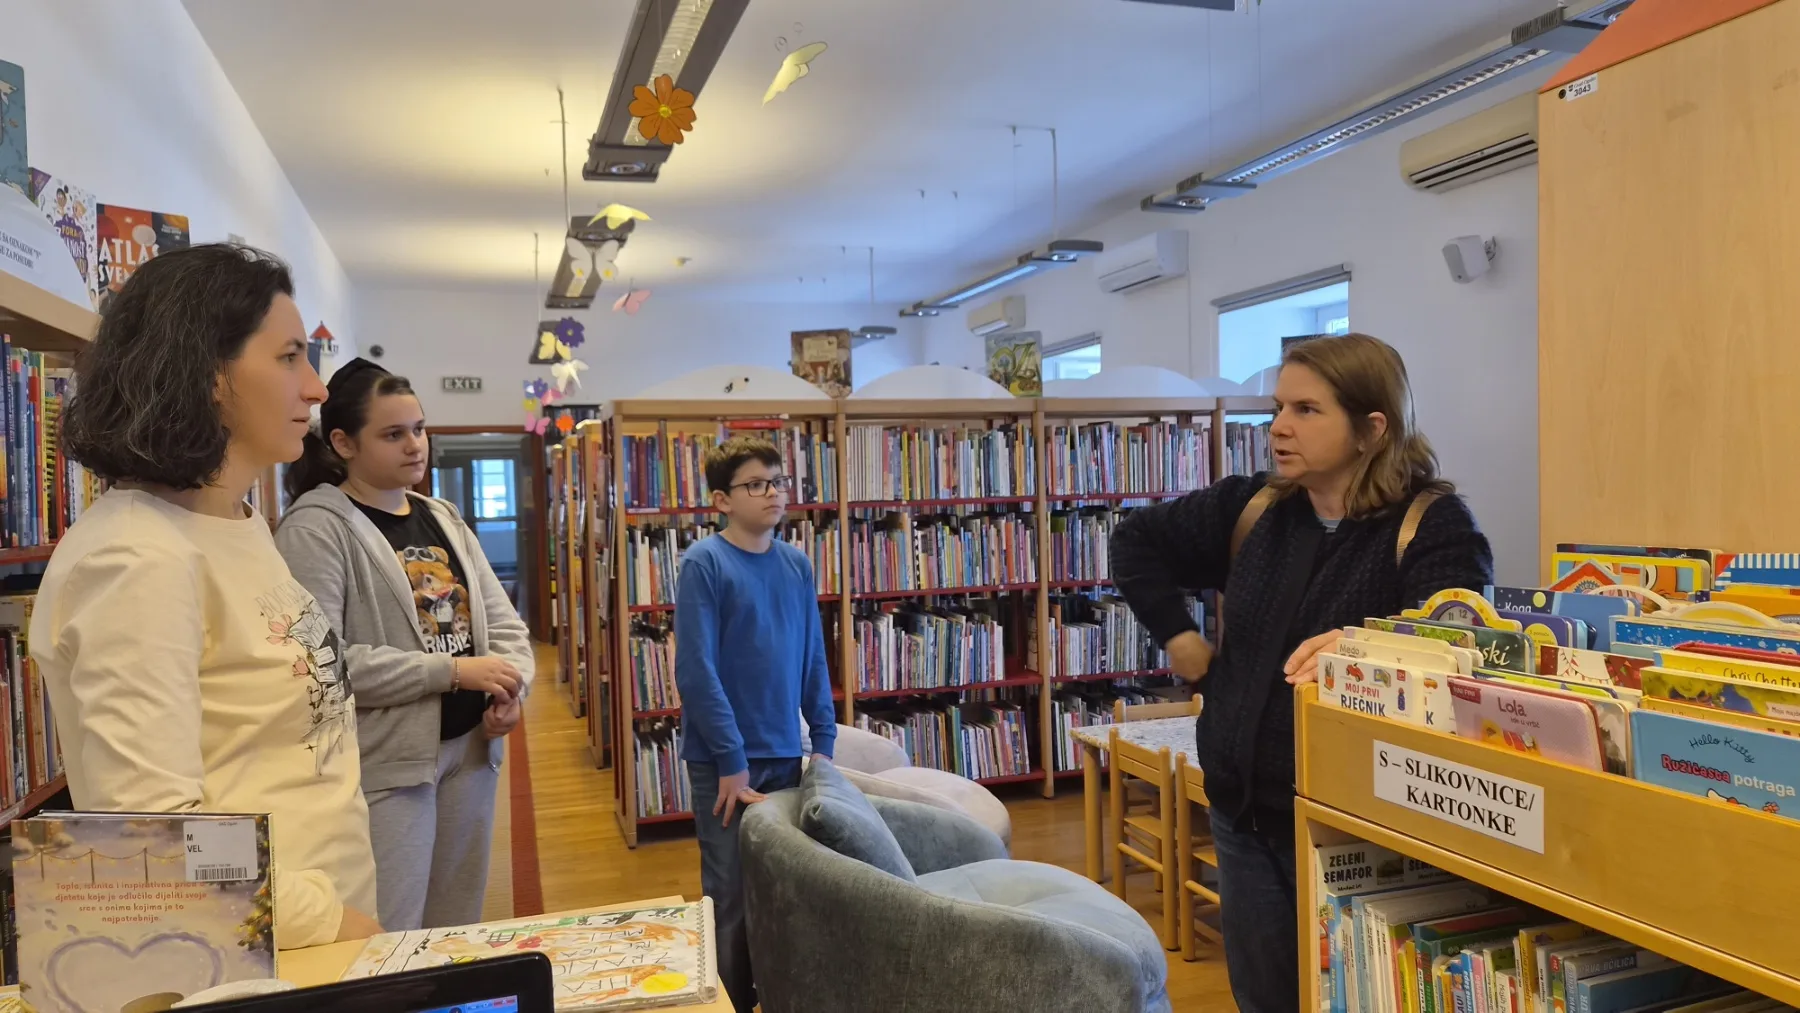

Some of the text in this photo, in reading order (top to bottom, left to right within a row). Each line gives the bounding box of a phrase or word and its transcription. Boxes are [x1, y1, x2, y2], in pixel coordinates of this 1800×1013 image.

[1574, 84, 1591, 97] 3043
[98, 236, 160, 266] ATLAS
[444, 379, 481, 389] EXIT
[1458, 609, 1468, 618] 12
[1345, 682, 1380, 699] MOJ PRVI
[1340, 694, 1386, 717] RJEČNIK
[1497, 696, 1527, 717] Lola
[1689, 734, 1755, 764] Hello Kitty
[1379, 750, 1389, 768] S
[1405, 757, 1535, 812] SLIKOVNICE/
[1661, 754, 1796, 797] Ružičasta potraga
[1406, 784, 1517, 837] KARTONKE
[1329, 852, 1365, 868] ZELENI
[1323, 866, 1373, 884] SEMAFOR
[87, 893, 106, 902] koje
[107, 893, 116, 902] je
[118, 892, 153, 900] odlučilo
[155, 891, 183, 900] dijeliti
[185, 892, 207, 901] svoje
[133, 904, 162, 912] kojima
[164, 904, 173, 912] je
